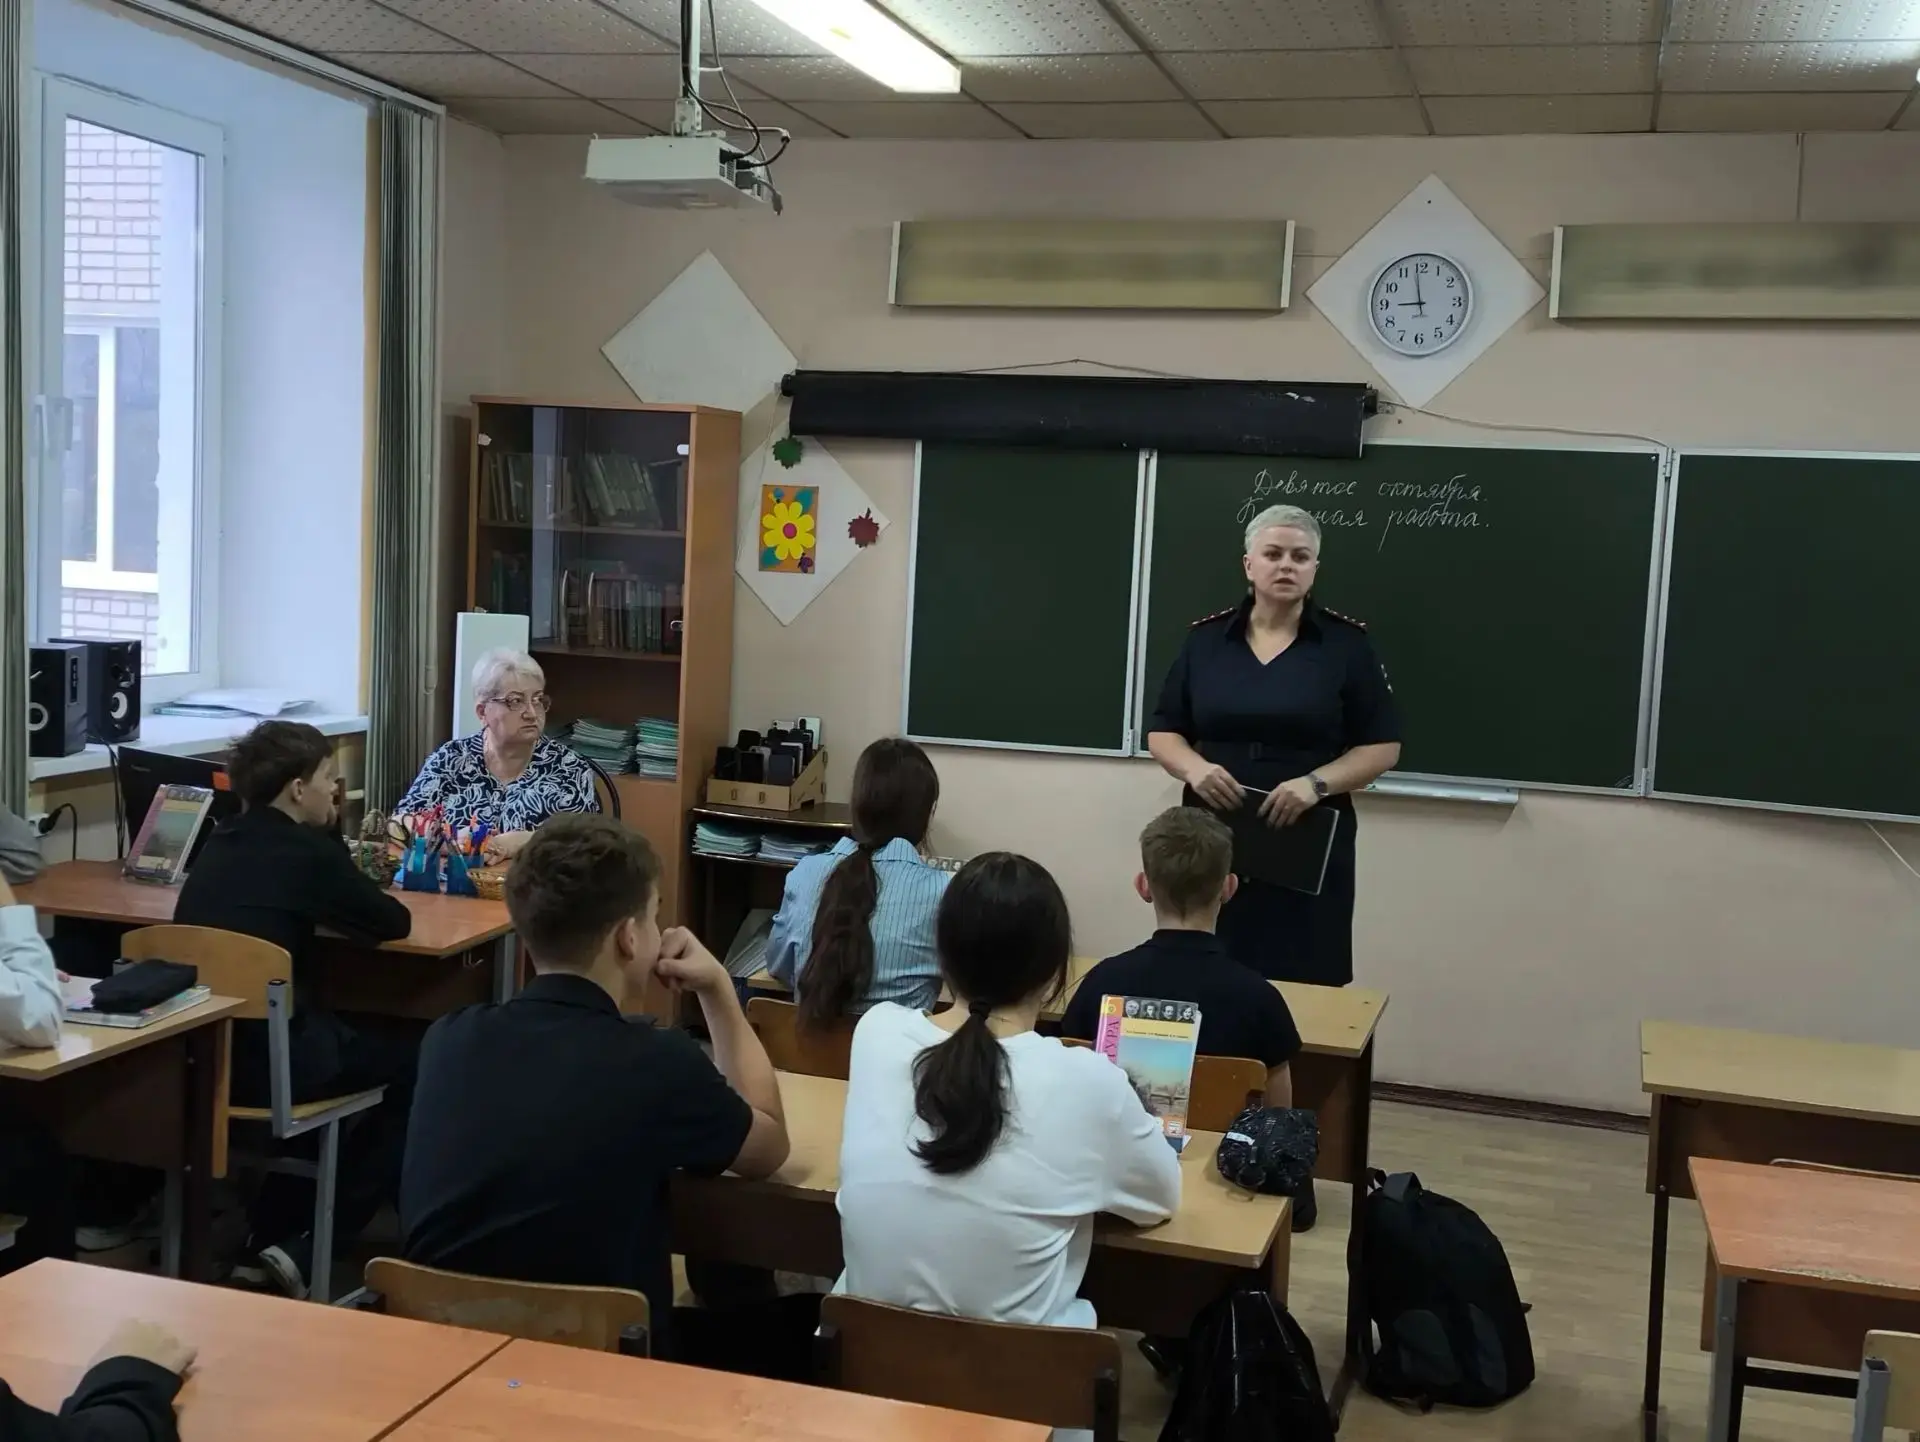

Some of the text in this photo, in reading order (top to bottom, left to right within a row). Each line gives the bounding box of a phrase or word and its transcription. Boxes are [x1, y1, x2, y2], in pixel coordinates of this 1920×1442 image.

[1399, 267, 1408, 278] 11
[1415, 262, 1428, 274] 12
[1436, 266, 1440, 276] 1
[1386, 282, 1398, 293] 10
[1446, 277, 1454, 288] 2
[1379, 299, 1389, 311] 9
[1452, 296, 1462, 308] 3
[1385, 316, 1395, 328] 8
[1446, 314, 1454, 325] 4
[1398, 330, 1406, 342] 7
[1414, 333, 1424, 345] 6
[1434, 327, 1443, 339] 5
[1253, 468, 1359, 496] Девятое
[1377, 501, 1490, 553] работа.
